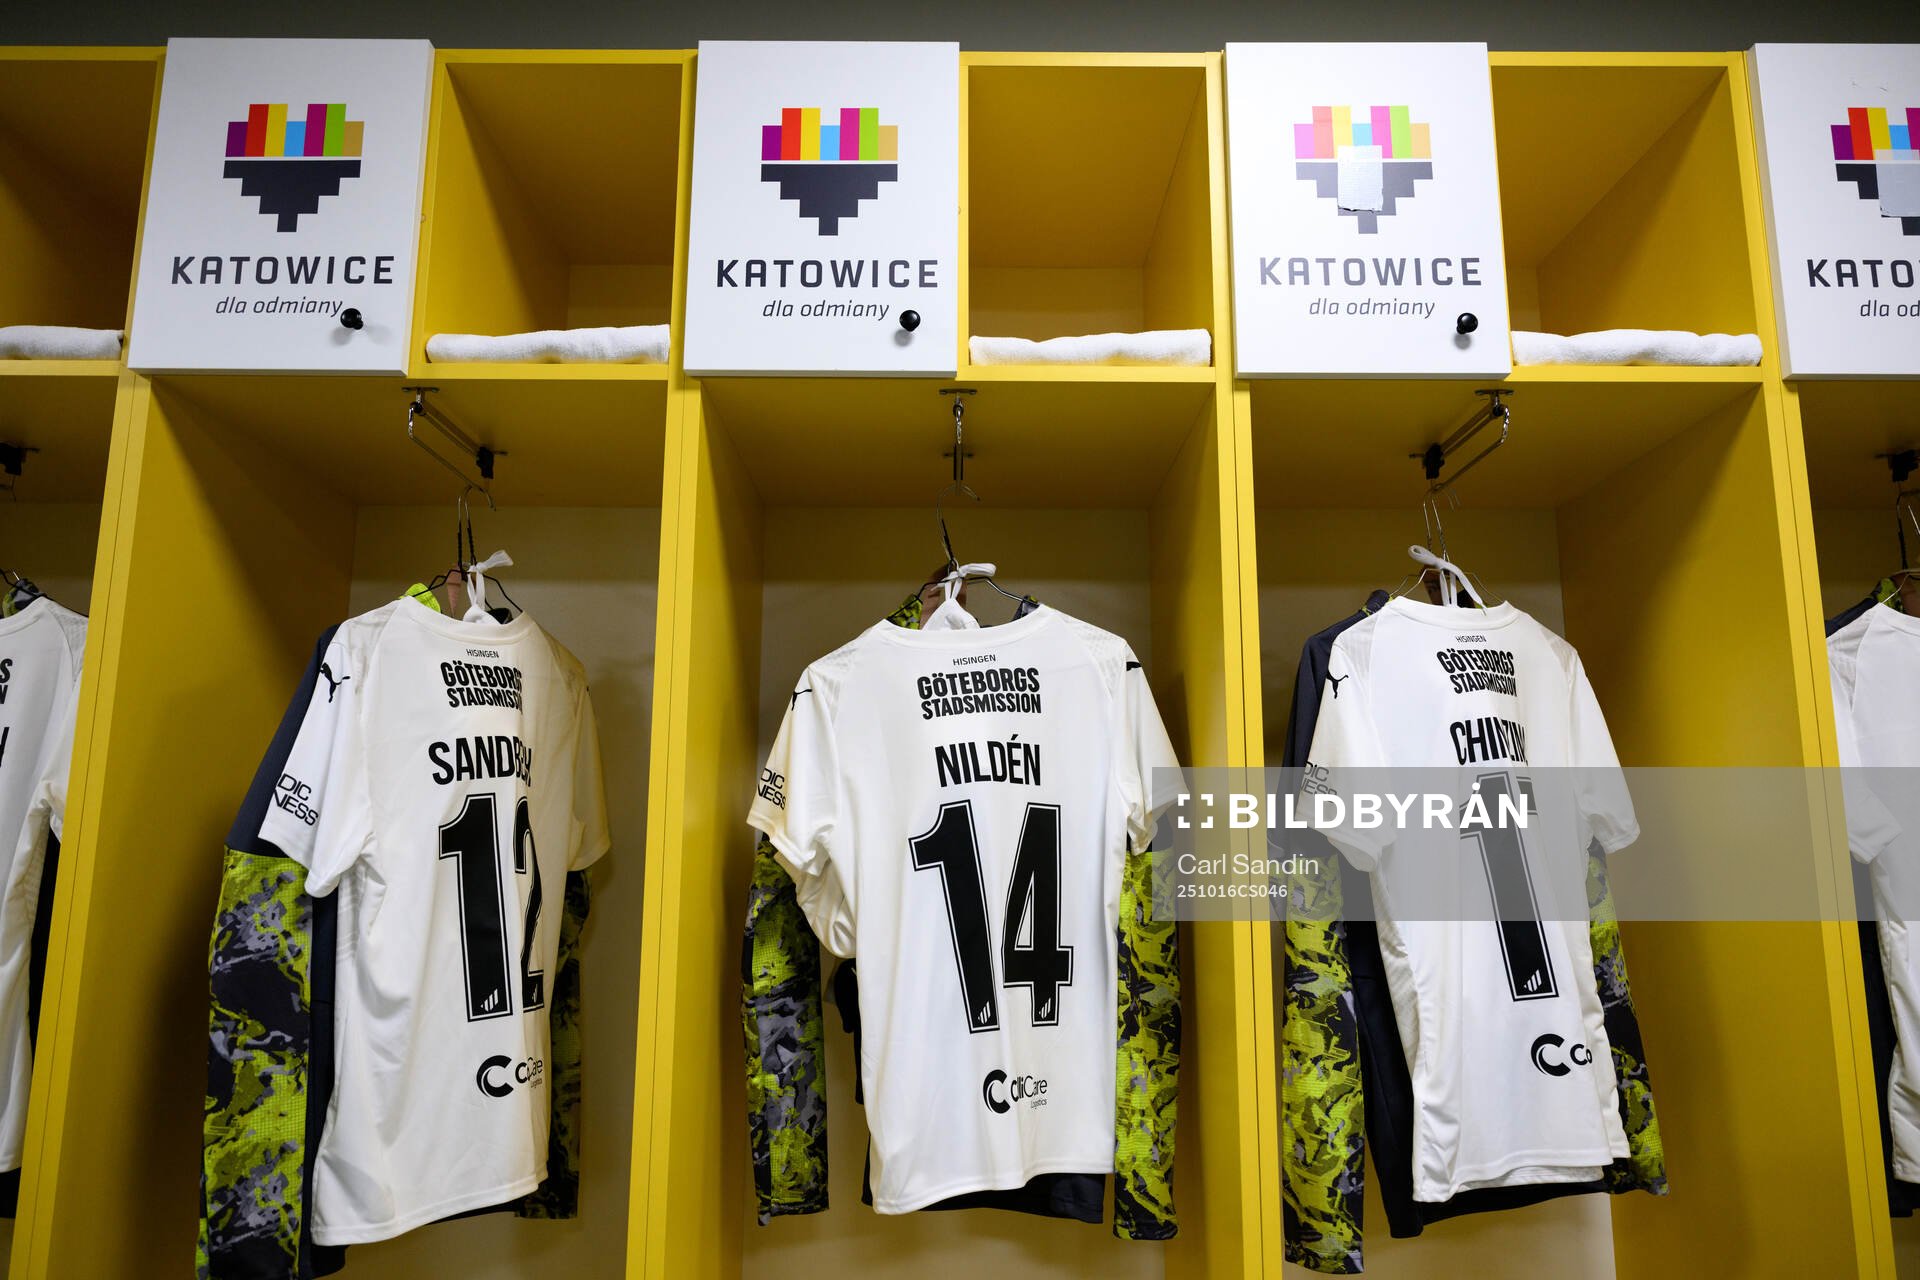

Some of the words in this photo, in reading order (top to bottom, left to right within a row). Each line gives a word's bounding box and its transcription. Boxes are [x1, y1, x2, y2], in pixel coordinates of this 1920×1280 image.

[171, 256, 395, 285] KATOWICE
[716, 259, 938, 288] KATOWICE
[1259, 257, 1482, 286] KATOWICE
[1806, 259, 1920, 288] KATO
[215, 296, 247, 314] dla
[253, 296, 343, 318] odmiany
[762, 299, 793, 317] dla
[800, 299, 889, 321] odmiany
[1309, 297, 1339, 315] dla
[1346, 297, 1435, 319] odmiany
[1860, 299, 1889, 317] dla
[466, 648, 499, 659] HISINGEN
[953, 654, 996, 666] HISINGEN
[1436, 648, 1515, 676] GÖTEBORGS
[917, 667, 1040, 700] GÖTEBORGS
[921, 693, 1042, 720] STADSMISSION
[935, 734, 1041, 787] NILDÉN
[277, 773, 312, 801] DIC
[438, 792, 544, 1022] 12
[908, 799, 1074, 1034] 14
